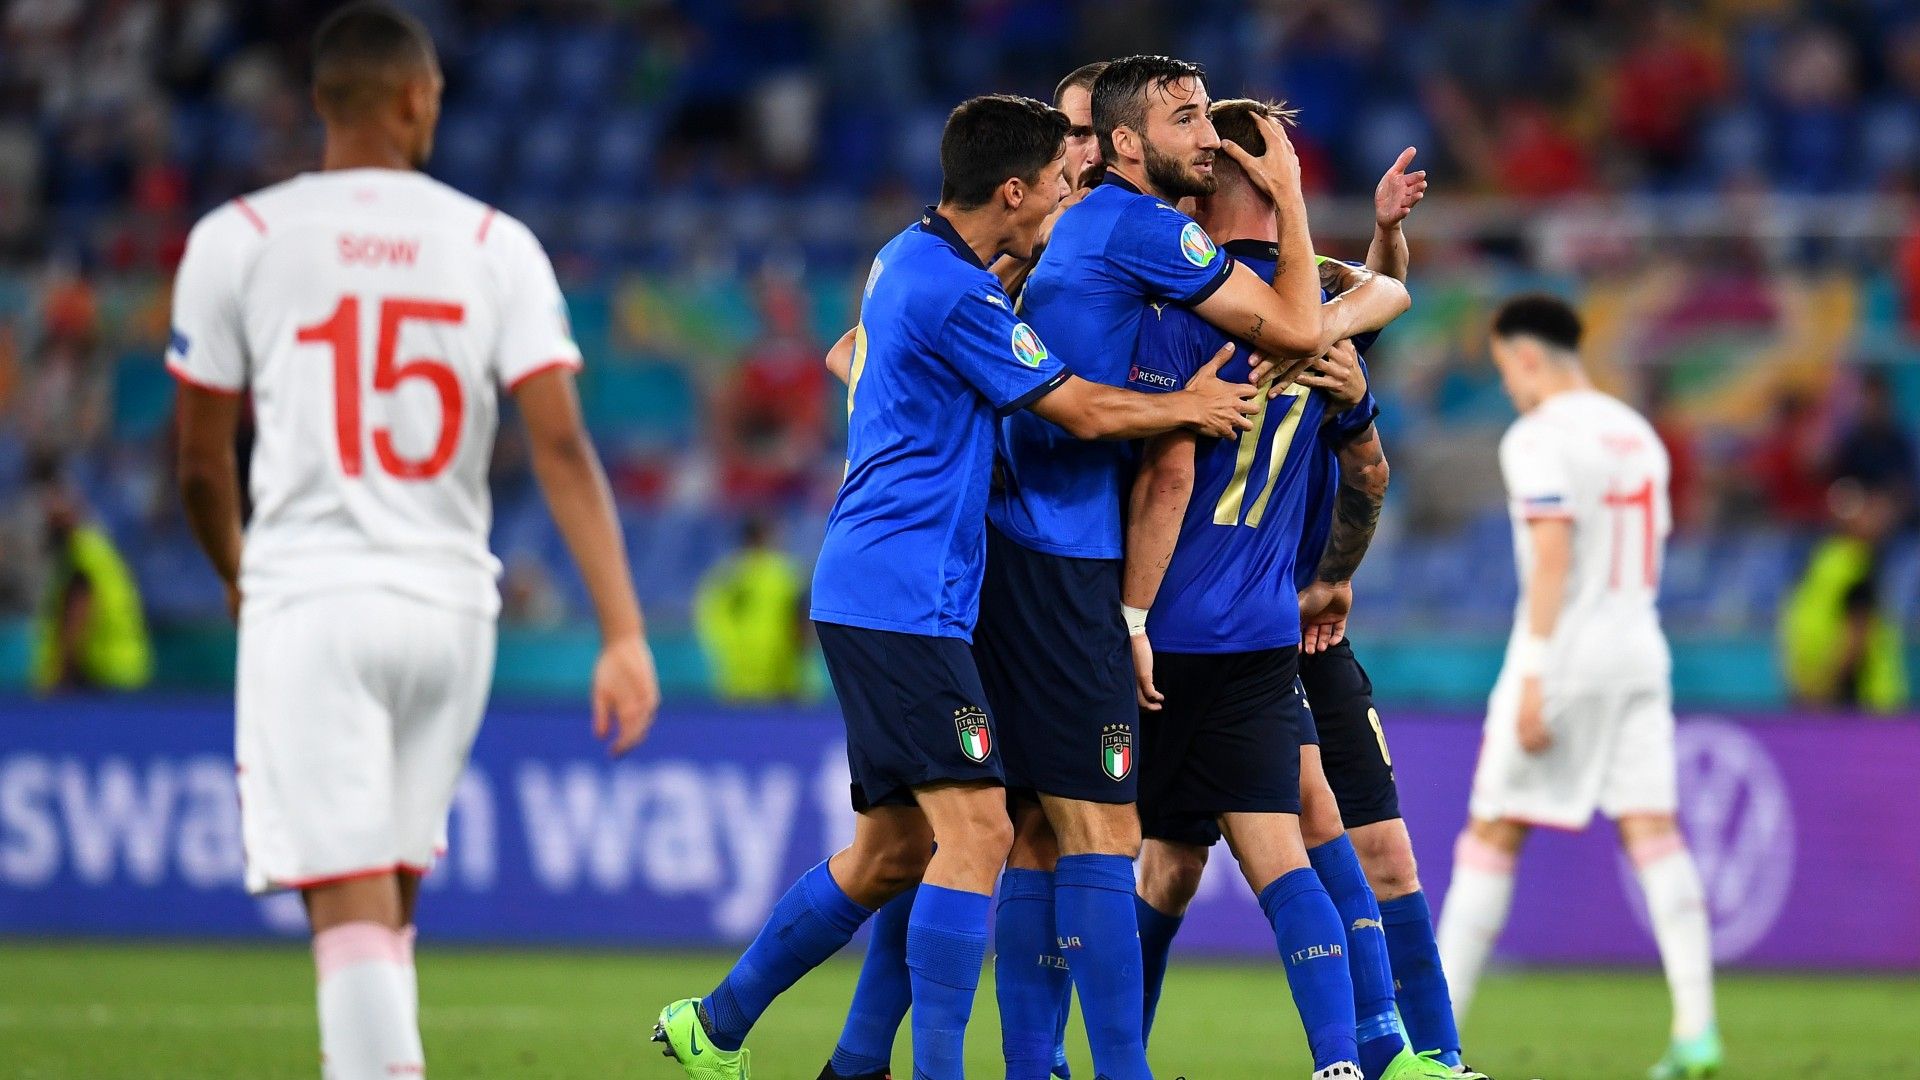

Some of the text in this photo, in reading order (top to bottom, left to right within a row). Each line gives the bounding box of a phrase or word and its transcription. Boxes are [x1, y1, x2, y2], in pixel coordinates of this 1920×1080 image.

[337, 233, 420, 267] SOW
[296, 291, 465, 481] 15
[1138, 371, 1177, 387] RESPECT
[1213, 372, 1314, 528] 17
[959, 717, 985, 728] ITALIA
[1105, 735, 1130, 745] ITALIA
[516, 758, 799, 942] way
[1038, 954, 1069, 968] ITA
[1291, 943, 1342, 965] ITALIA
